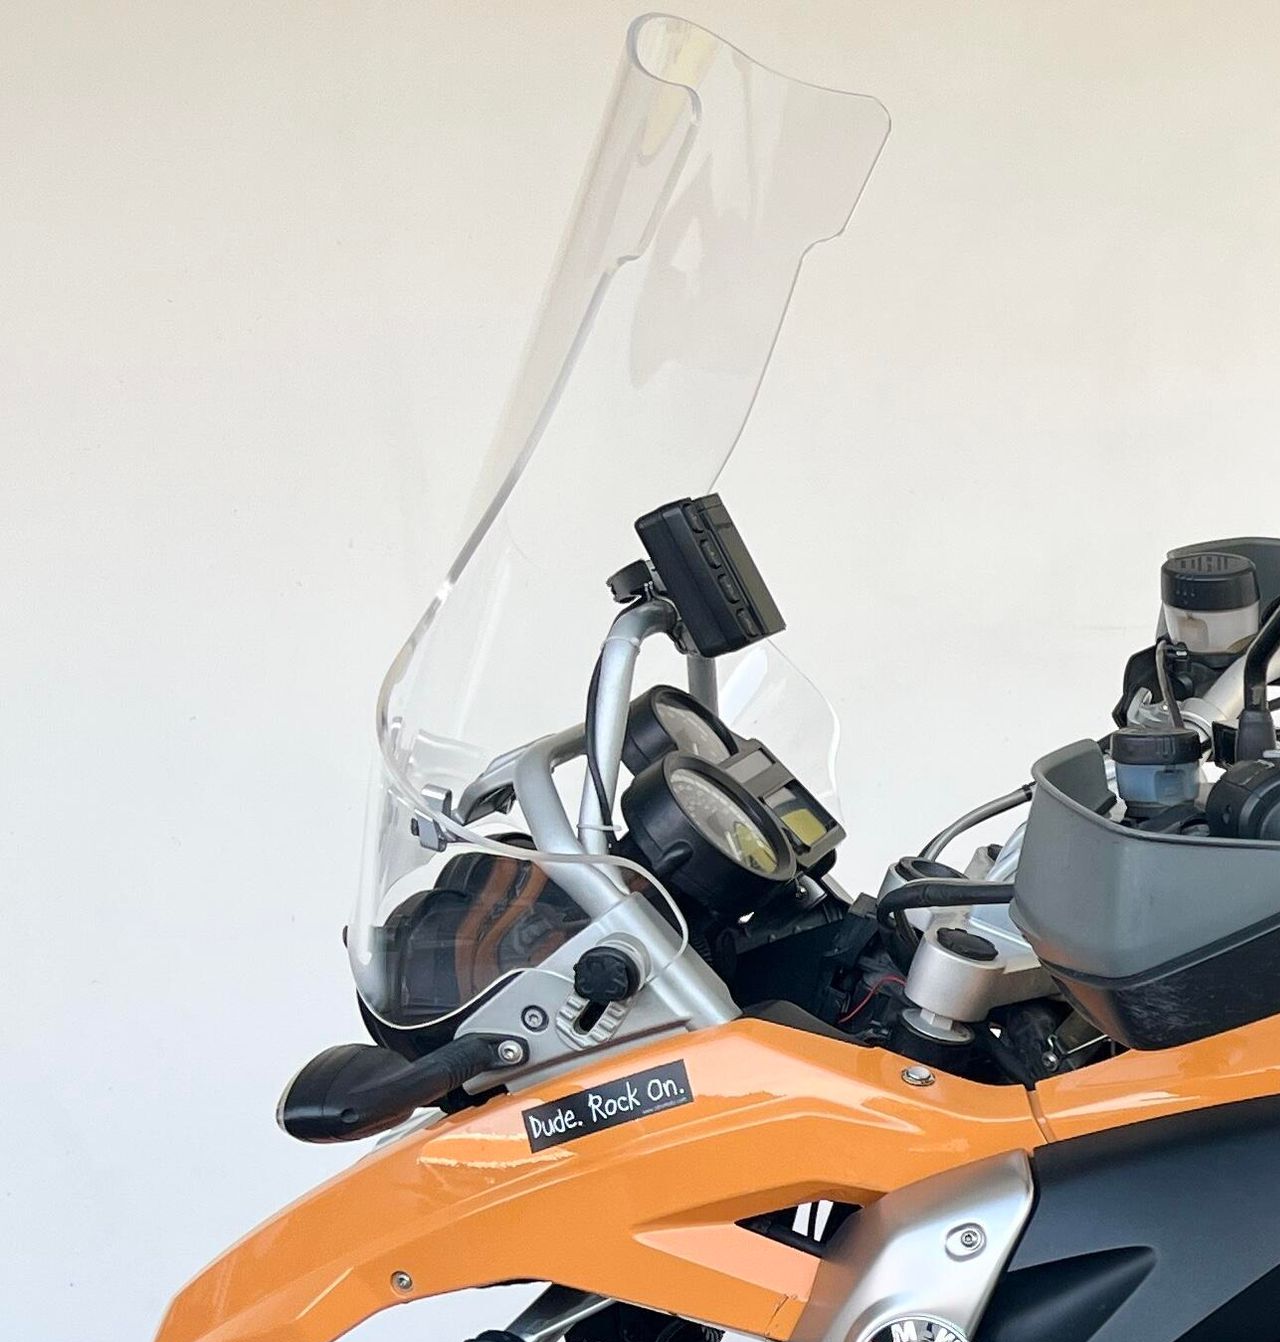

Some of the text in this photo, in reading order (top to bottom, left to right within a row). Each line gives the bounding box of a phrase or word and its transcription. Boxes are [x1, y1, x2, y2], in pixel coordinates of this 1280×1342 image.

[528, 1109, 584, 1139] Dude.
[587, 1081, 641, 1123] Rock
[647, 1078, 685, 1102] On.
